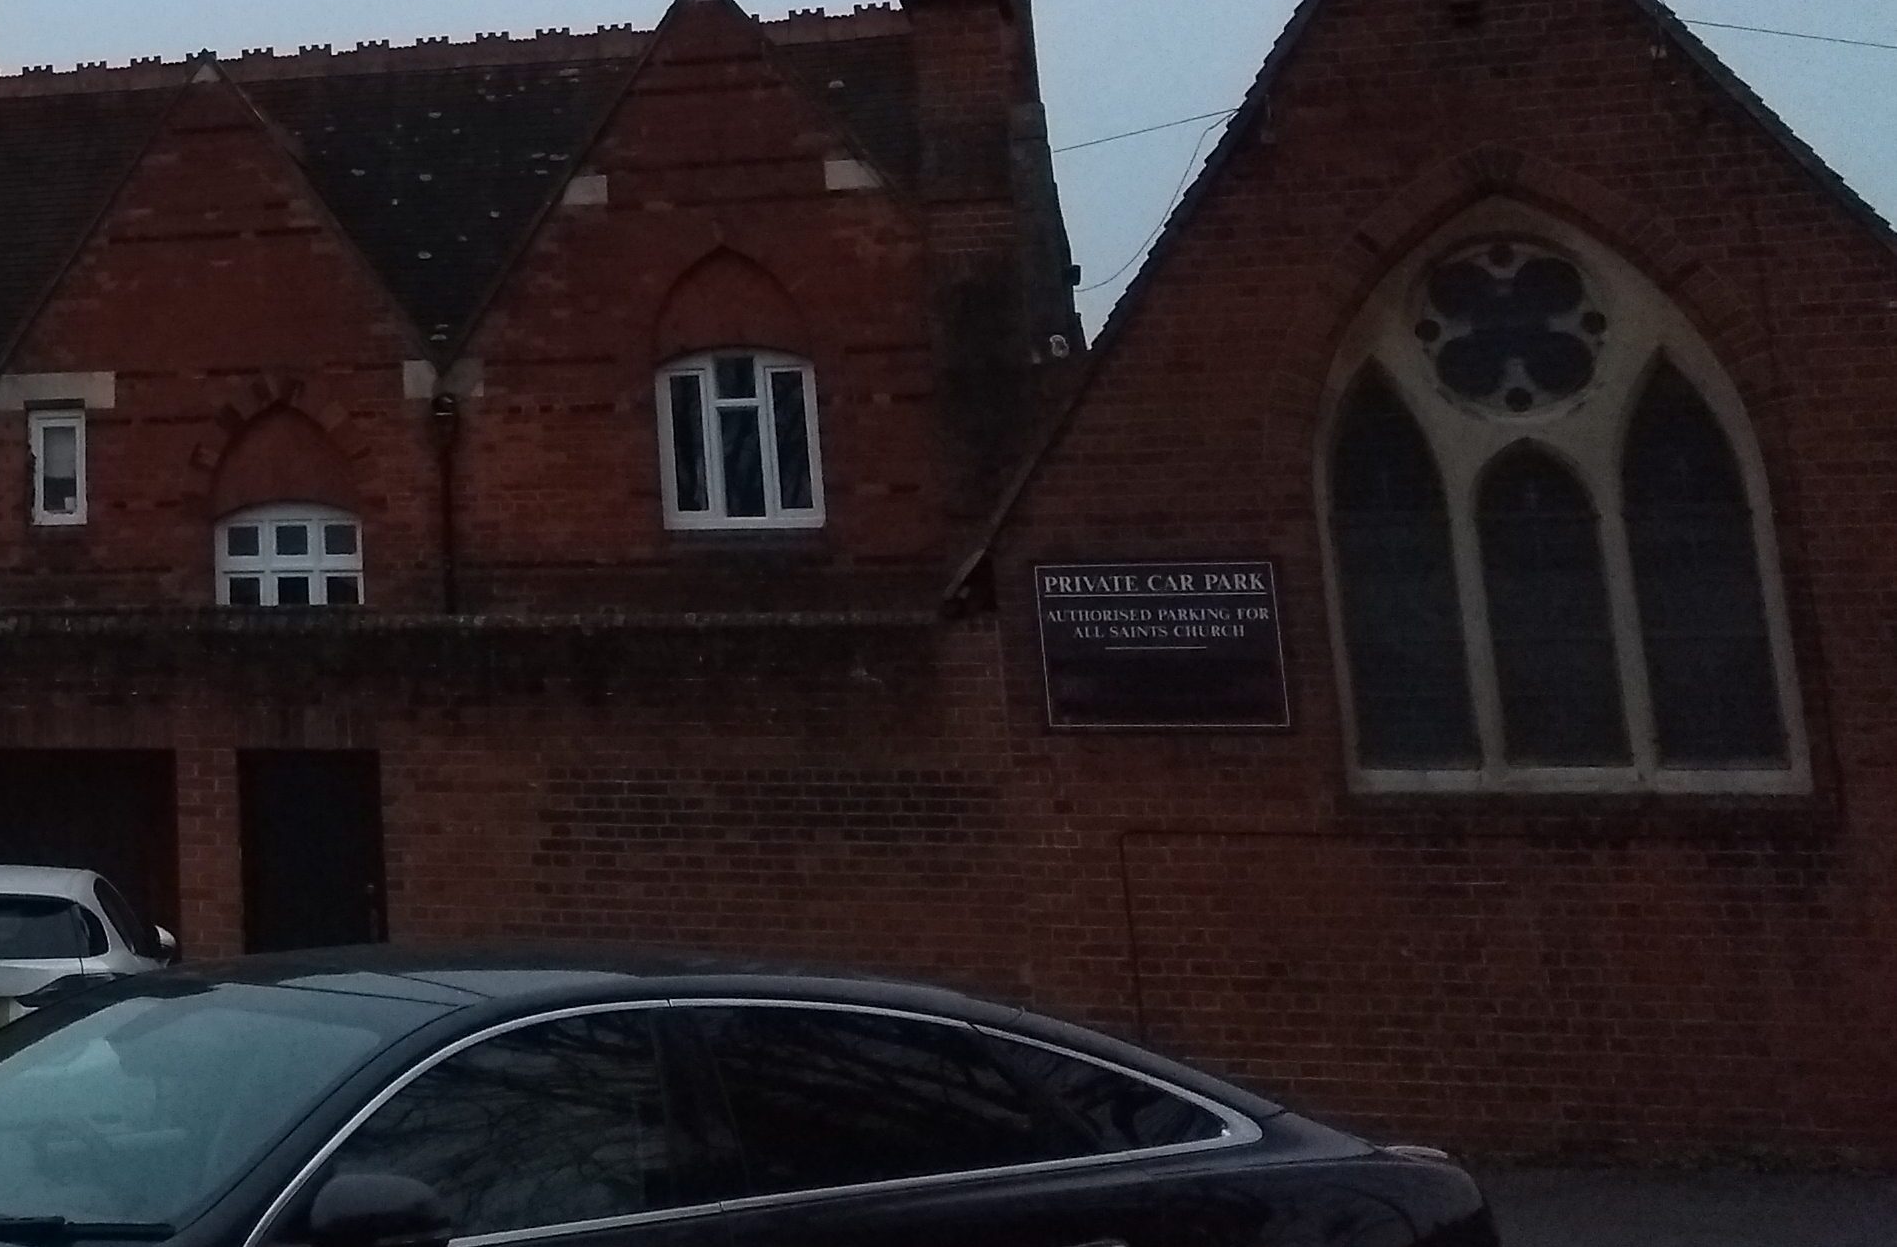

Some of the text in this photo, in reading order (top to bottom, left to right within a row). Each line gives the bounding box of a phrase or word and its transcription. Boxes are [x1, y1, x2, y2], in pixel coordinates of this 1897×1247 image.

[1044, 573, 1266, 593] PRIVATE CAR PARK
[1047, 608, 1270, 622] AUTHORISED PARKING FOR
[1074, 625, 1246, 639] ALL SAINTS CHURCH
